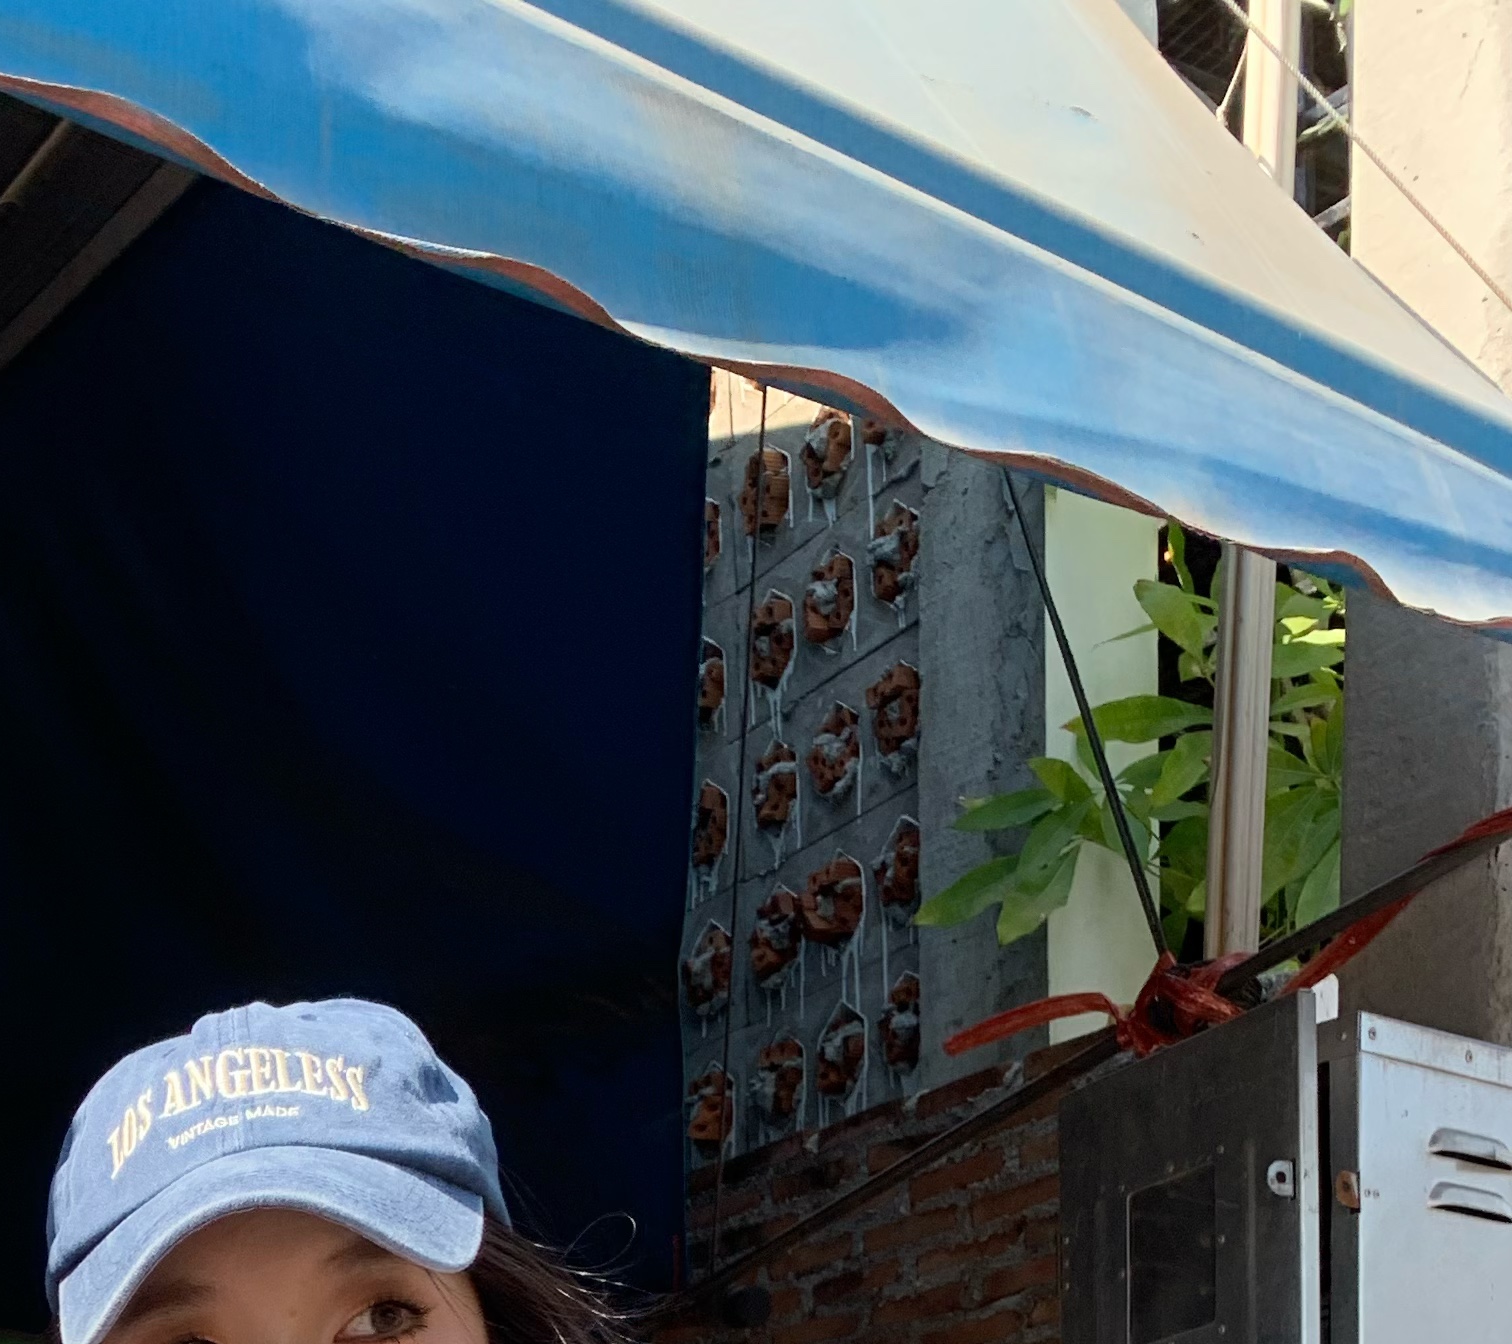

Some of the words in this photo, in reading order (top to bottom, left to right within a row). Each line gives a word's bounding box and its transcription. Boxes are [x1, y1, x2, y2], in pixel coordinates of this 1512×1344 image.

[106, 1087, 153, 1180] LOS
[158, 1046, 370, 1119] ANGELESS
[165, 1113, 240, 1150] VINTAGE
[245, 1105, 300, 1121] MADE
